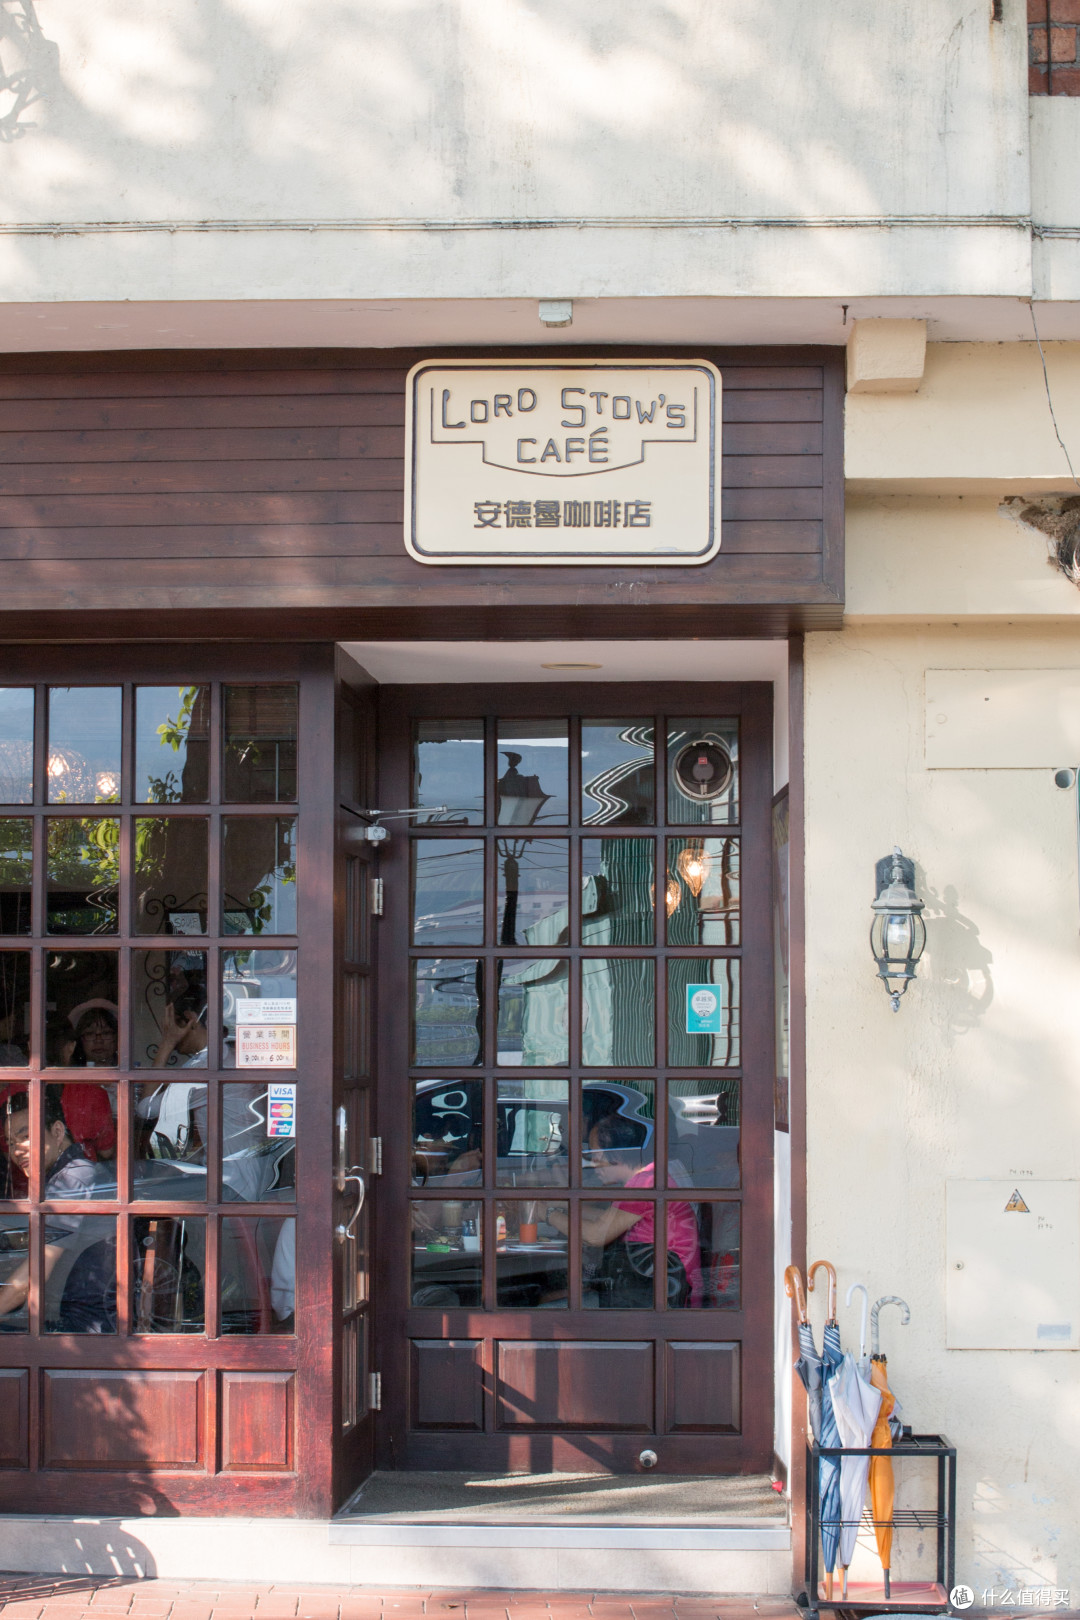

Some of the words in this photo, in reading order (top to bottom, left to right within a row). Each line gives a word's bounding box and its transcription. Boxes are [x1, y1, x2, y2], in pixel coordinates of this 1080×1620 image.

[442, 388, 537, 428] LORD
[517, 426, 609, 463] CAFÉ
[474, 500, 652, 528] 安德魯咖啡店
[242, 1042, 269, 1050] BUSINESS
[271, 1042, 290, 1050] HOURS
[273, 1087, 293, 1095] VISA
